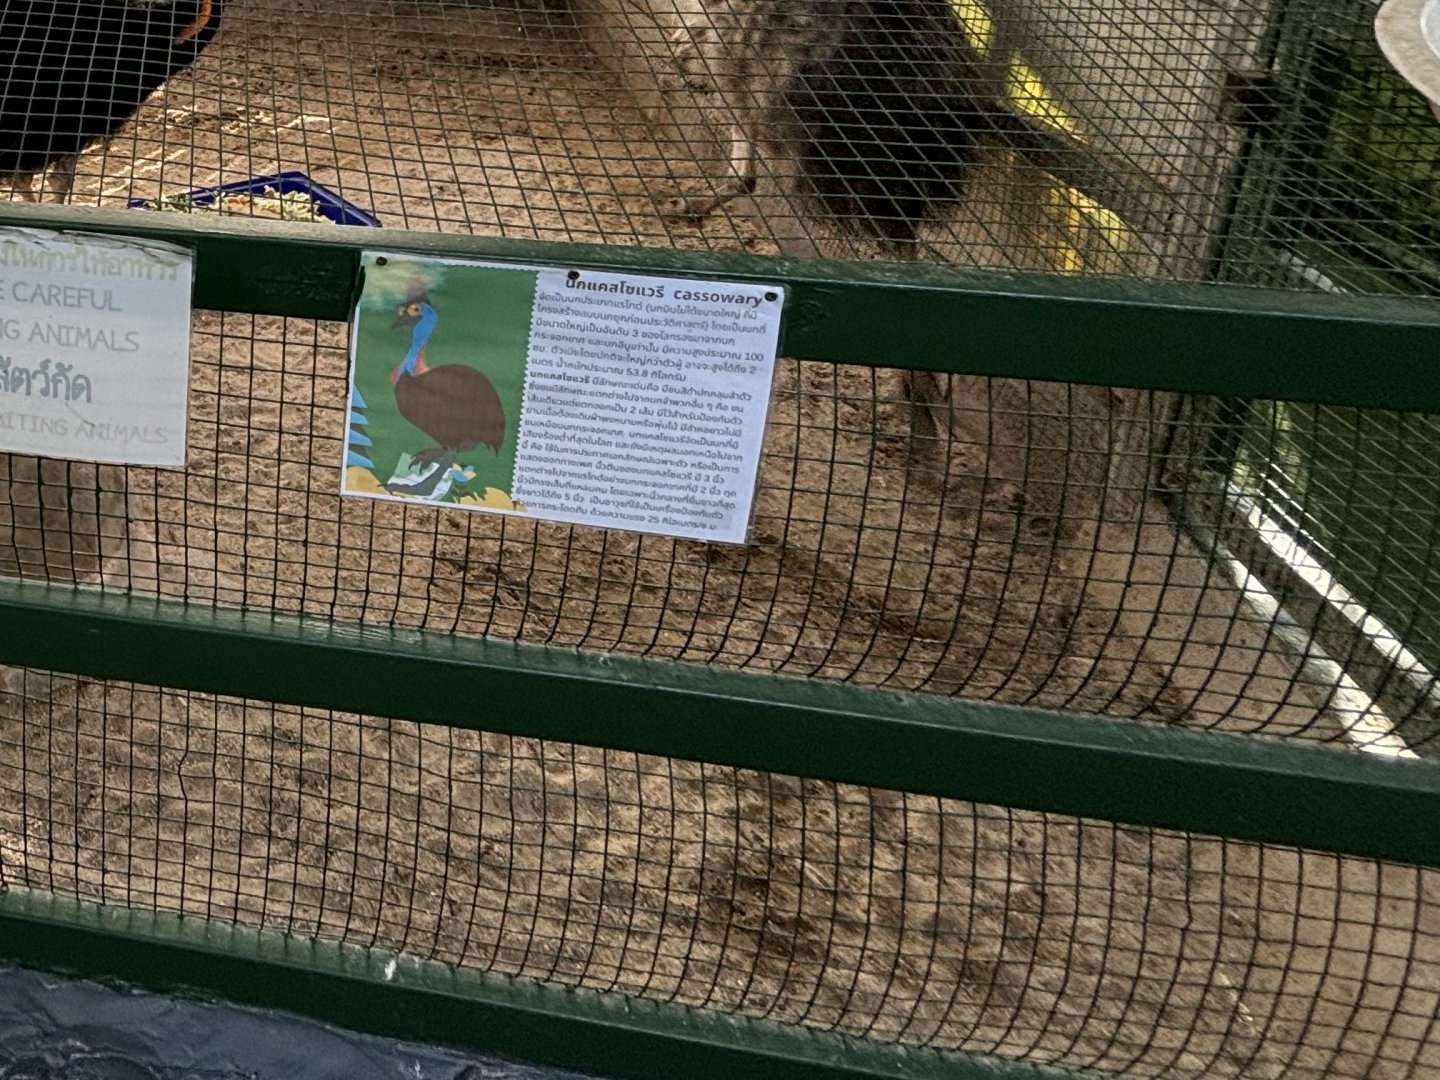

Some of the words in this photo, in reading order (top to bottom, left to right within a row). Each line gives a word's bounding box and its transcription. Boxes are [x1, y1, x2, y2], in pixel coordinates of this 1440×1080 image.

[12, 281, 123, 313] CAREFUL
[565, 277, 664, 298] นกแคสโซแวรี
[673, 289, 762, 308] cassowary
[631, 328, 639, 337] 3
[27, 322, 140, 353] ANIMALS
[744, 351, 764, 361] 100
[625, 367, 648, 377] 53.8
[748, 365, 757, 374] 2
[629, 405, 636, 414] 2
[74, 418, 169, 445] ANIMALS
[703, 474, 710, 482] 3
[700, 485, 707, 494] 2
[564, 492, 570, 500] 5
[647, 514, 659, 523] 25
